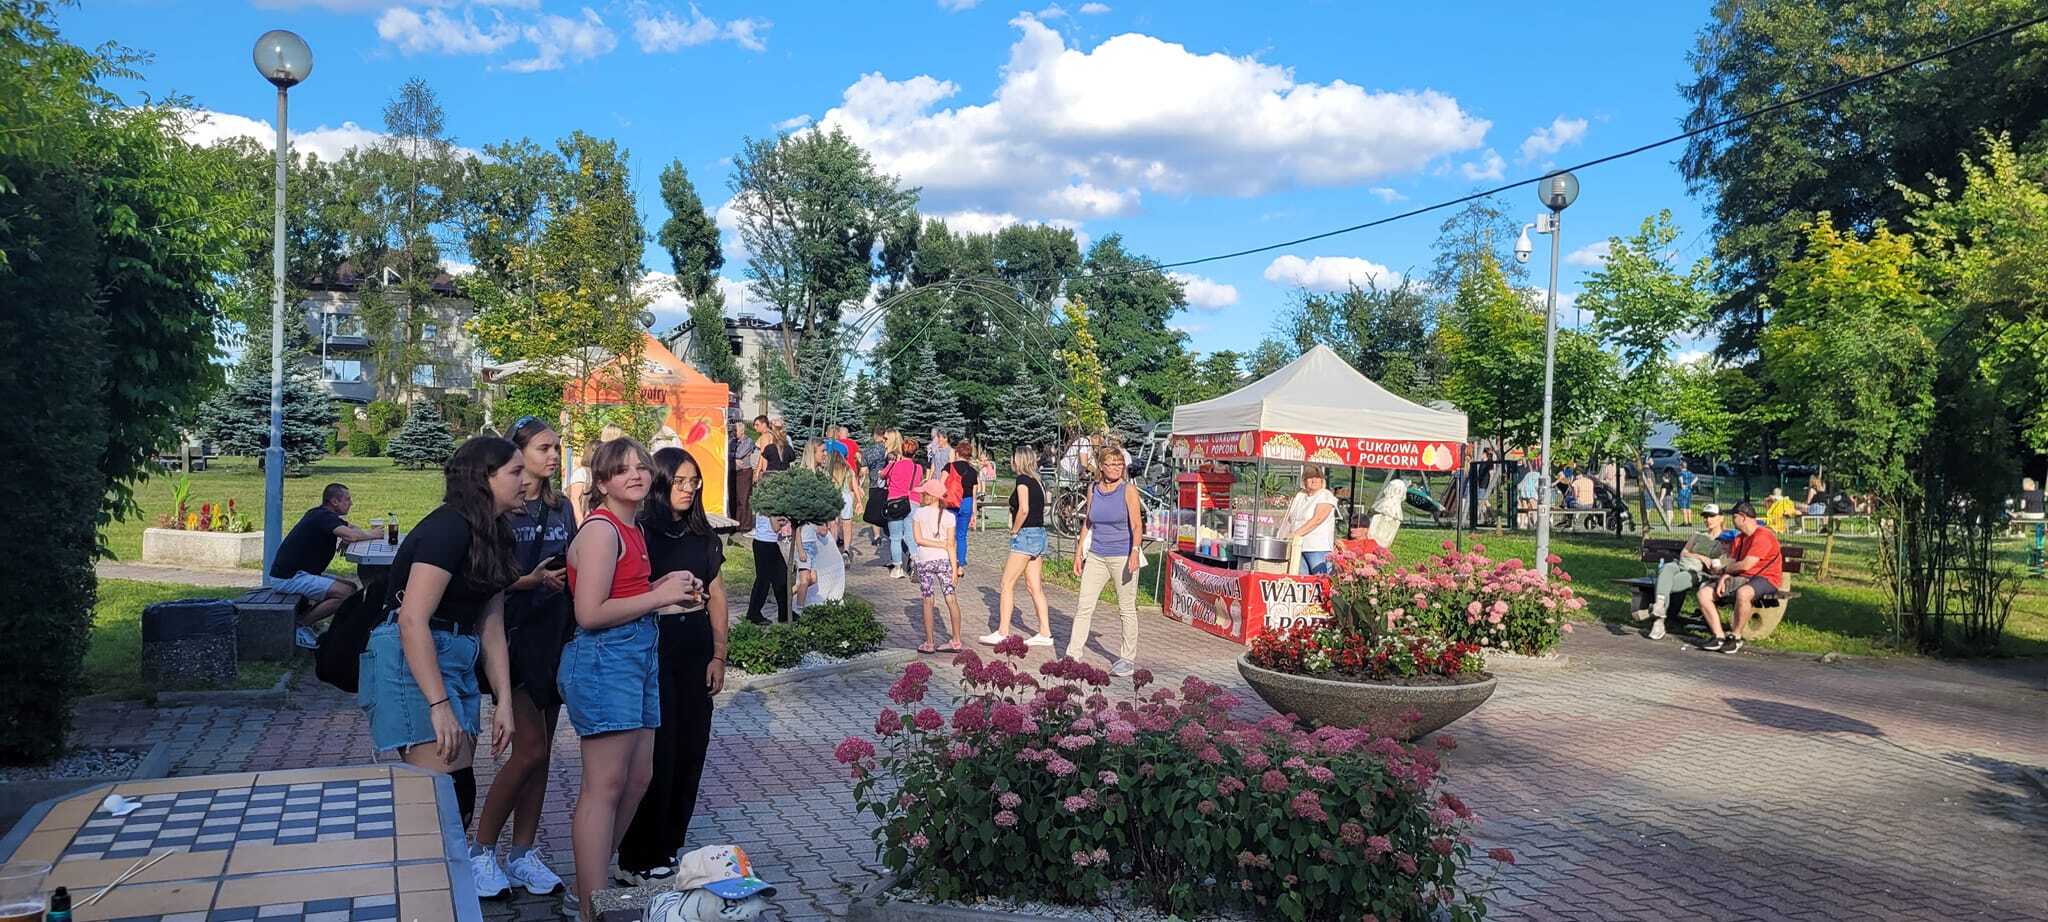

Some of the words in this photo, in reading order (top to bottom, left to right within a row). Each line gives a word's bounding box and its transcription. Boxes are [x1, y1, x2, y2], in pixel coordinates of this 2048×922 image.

[1211, 444, 1238, 455] POPCORN
[1315, 436, 1349, 449] WATA
[1357, 440, 1419, 454] CUKROWA
[1346, 452, 1350, 462] I
[1359, 453, 1418, 466] POPCORN
[1260, 580, 1324, 603] WATA
